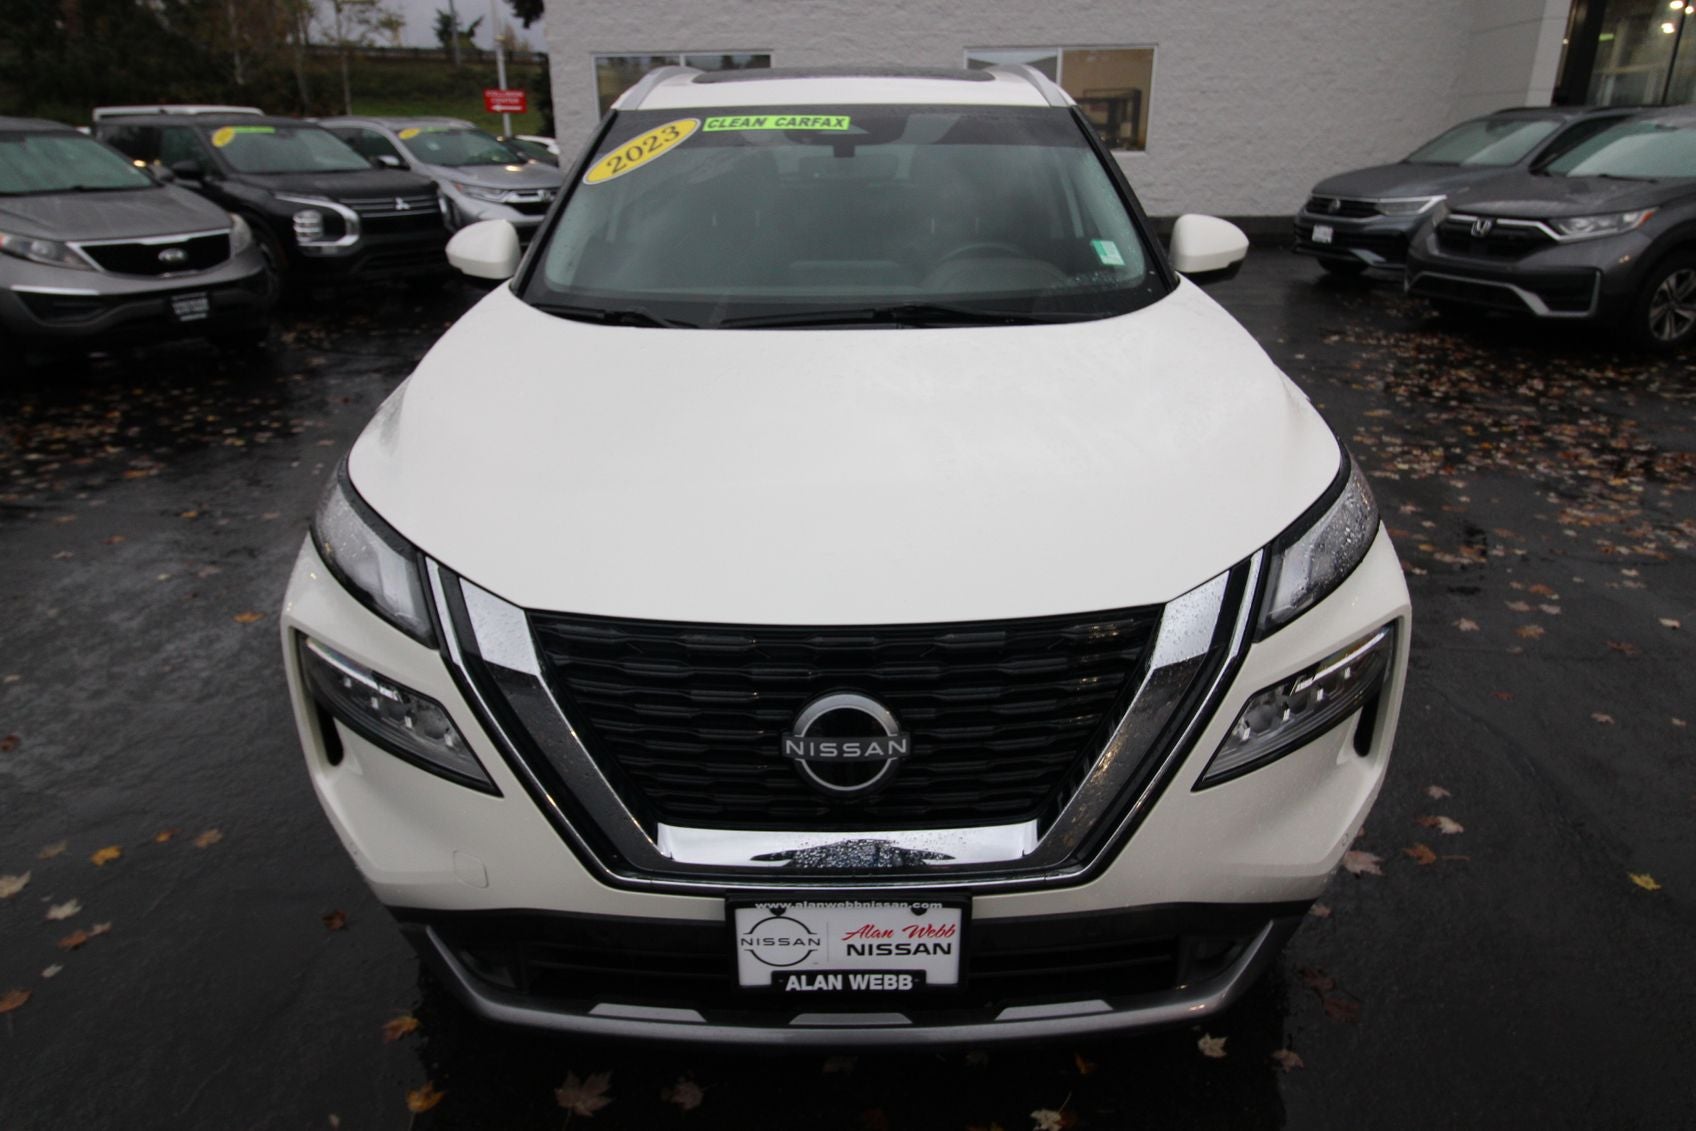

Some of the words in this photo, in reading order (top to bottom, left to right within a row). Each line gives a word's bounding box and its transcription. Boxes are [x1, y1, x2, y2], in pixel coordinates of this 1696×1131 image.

[706, 117, 766, 130] CLEAN
[774, 116, 847, 129] CARFAX
[606, 124, 681, 175] 2023
[785, 738, 907, 758] NISSAN
[755, 901, 943, 909] www.alanwebbnissan.com
[841, 924, 894, 941] Alan
[902, 923, 956, 940] Webb
[740, 937, 821, 947] NISSAN
[846, 942, 952, 957] NISSAN
[785, 974, 843, 991] ALAN
[849, 973, 913, 991] WEBB
